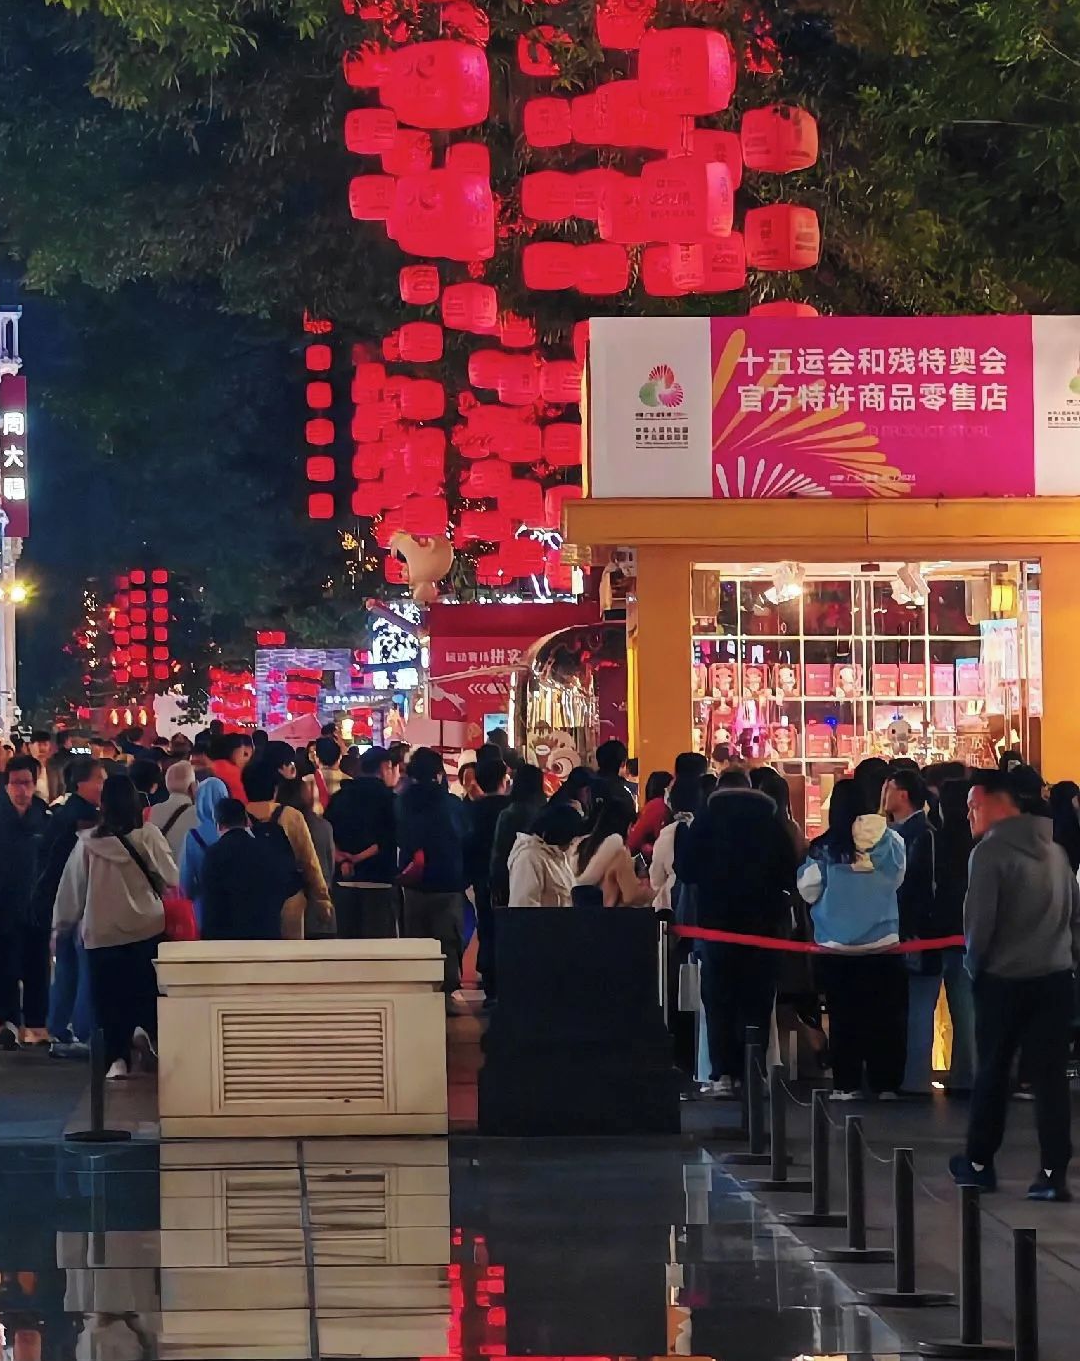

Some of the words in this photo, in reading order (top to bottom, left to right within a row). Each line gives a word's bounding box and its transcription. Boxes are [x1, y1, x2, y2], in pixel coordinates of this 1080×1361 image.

[737, 346, 1007, 377] 十五运会和残特奥会
[737, 382, 1007, 413] 官方特许商品零售店
